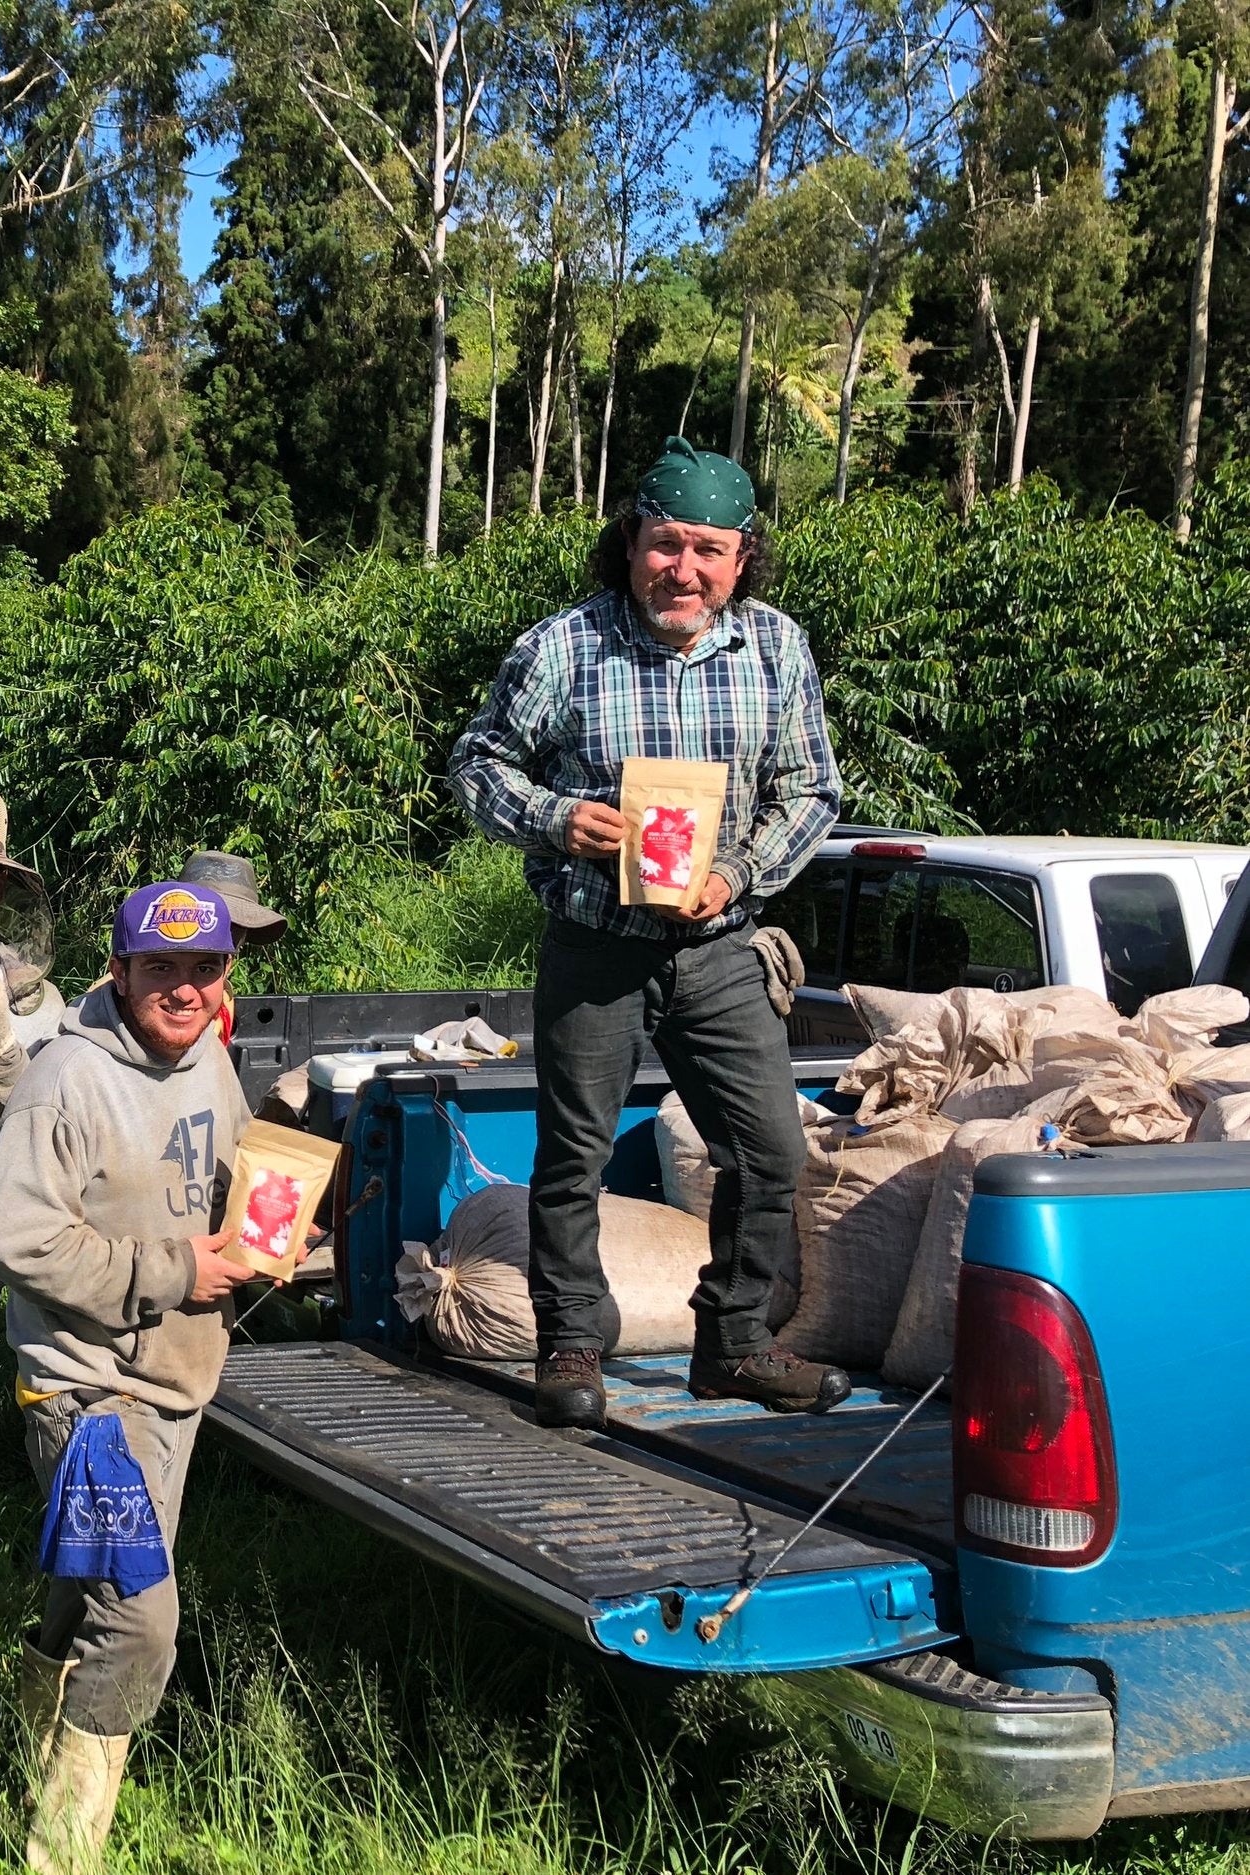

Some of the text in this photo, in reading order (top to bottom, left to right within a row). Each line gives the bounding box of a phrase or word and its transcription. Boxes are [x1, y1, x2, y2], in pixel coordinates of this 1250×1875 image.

[143, 904, 216, 931] LAKERS
[166, 1177, 226, 1217] LRG
[846, 1713, 894, 1758] 09 19
